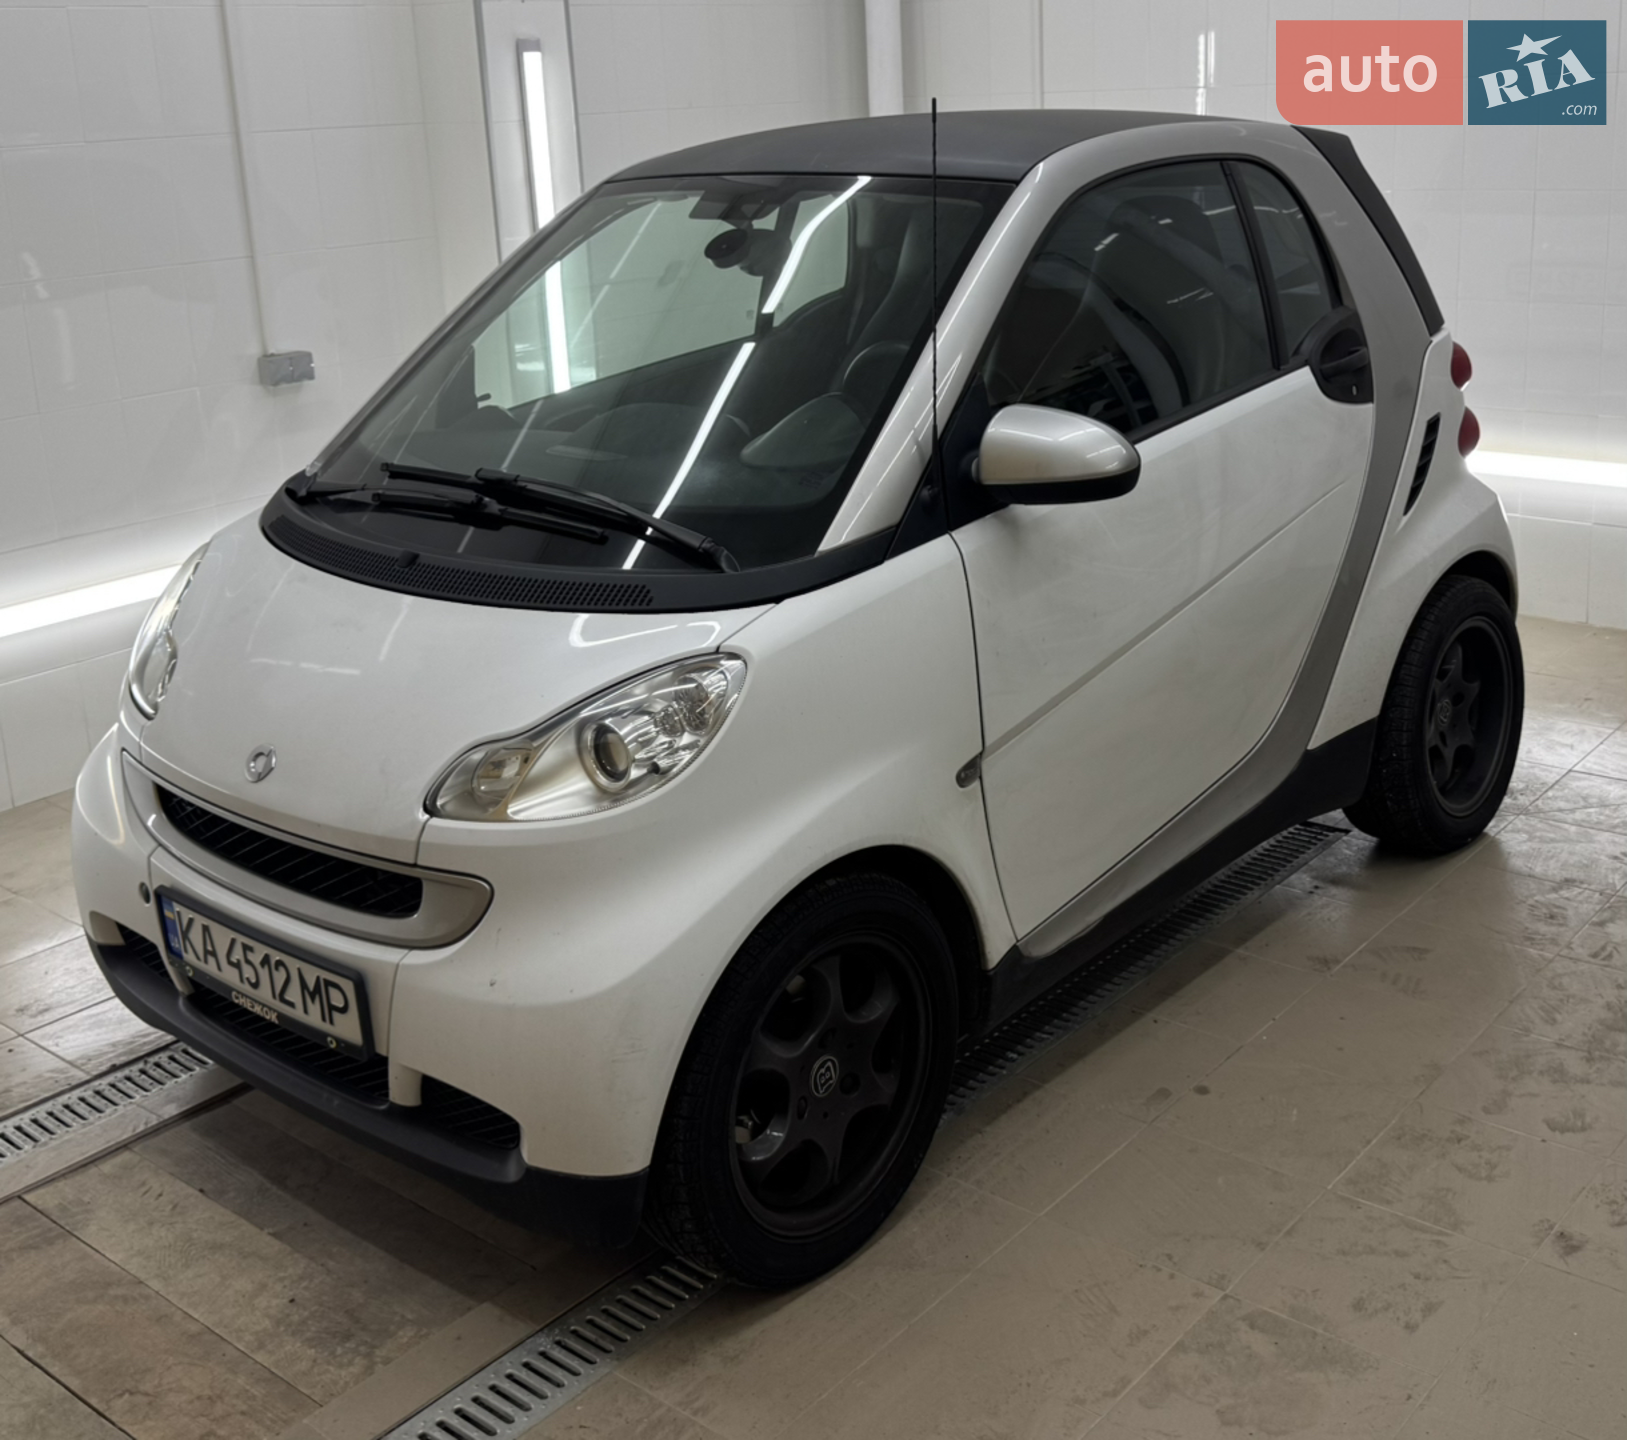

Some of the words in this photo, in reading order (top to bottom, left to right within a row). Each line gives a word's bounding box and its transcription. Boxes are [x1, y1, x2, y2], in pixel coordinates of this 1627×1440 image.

[176, 908, 223, 973] KA
[226, 936, 296, 1009] 4512
[297, 965, 349, 1027] MP
[231, 990, 280, 1025] СНЕЖОК
